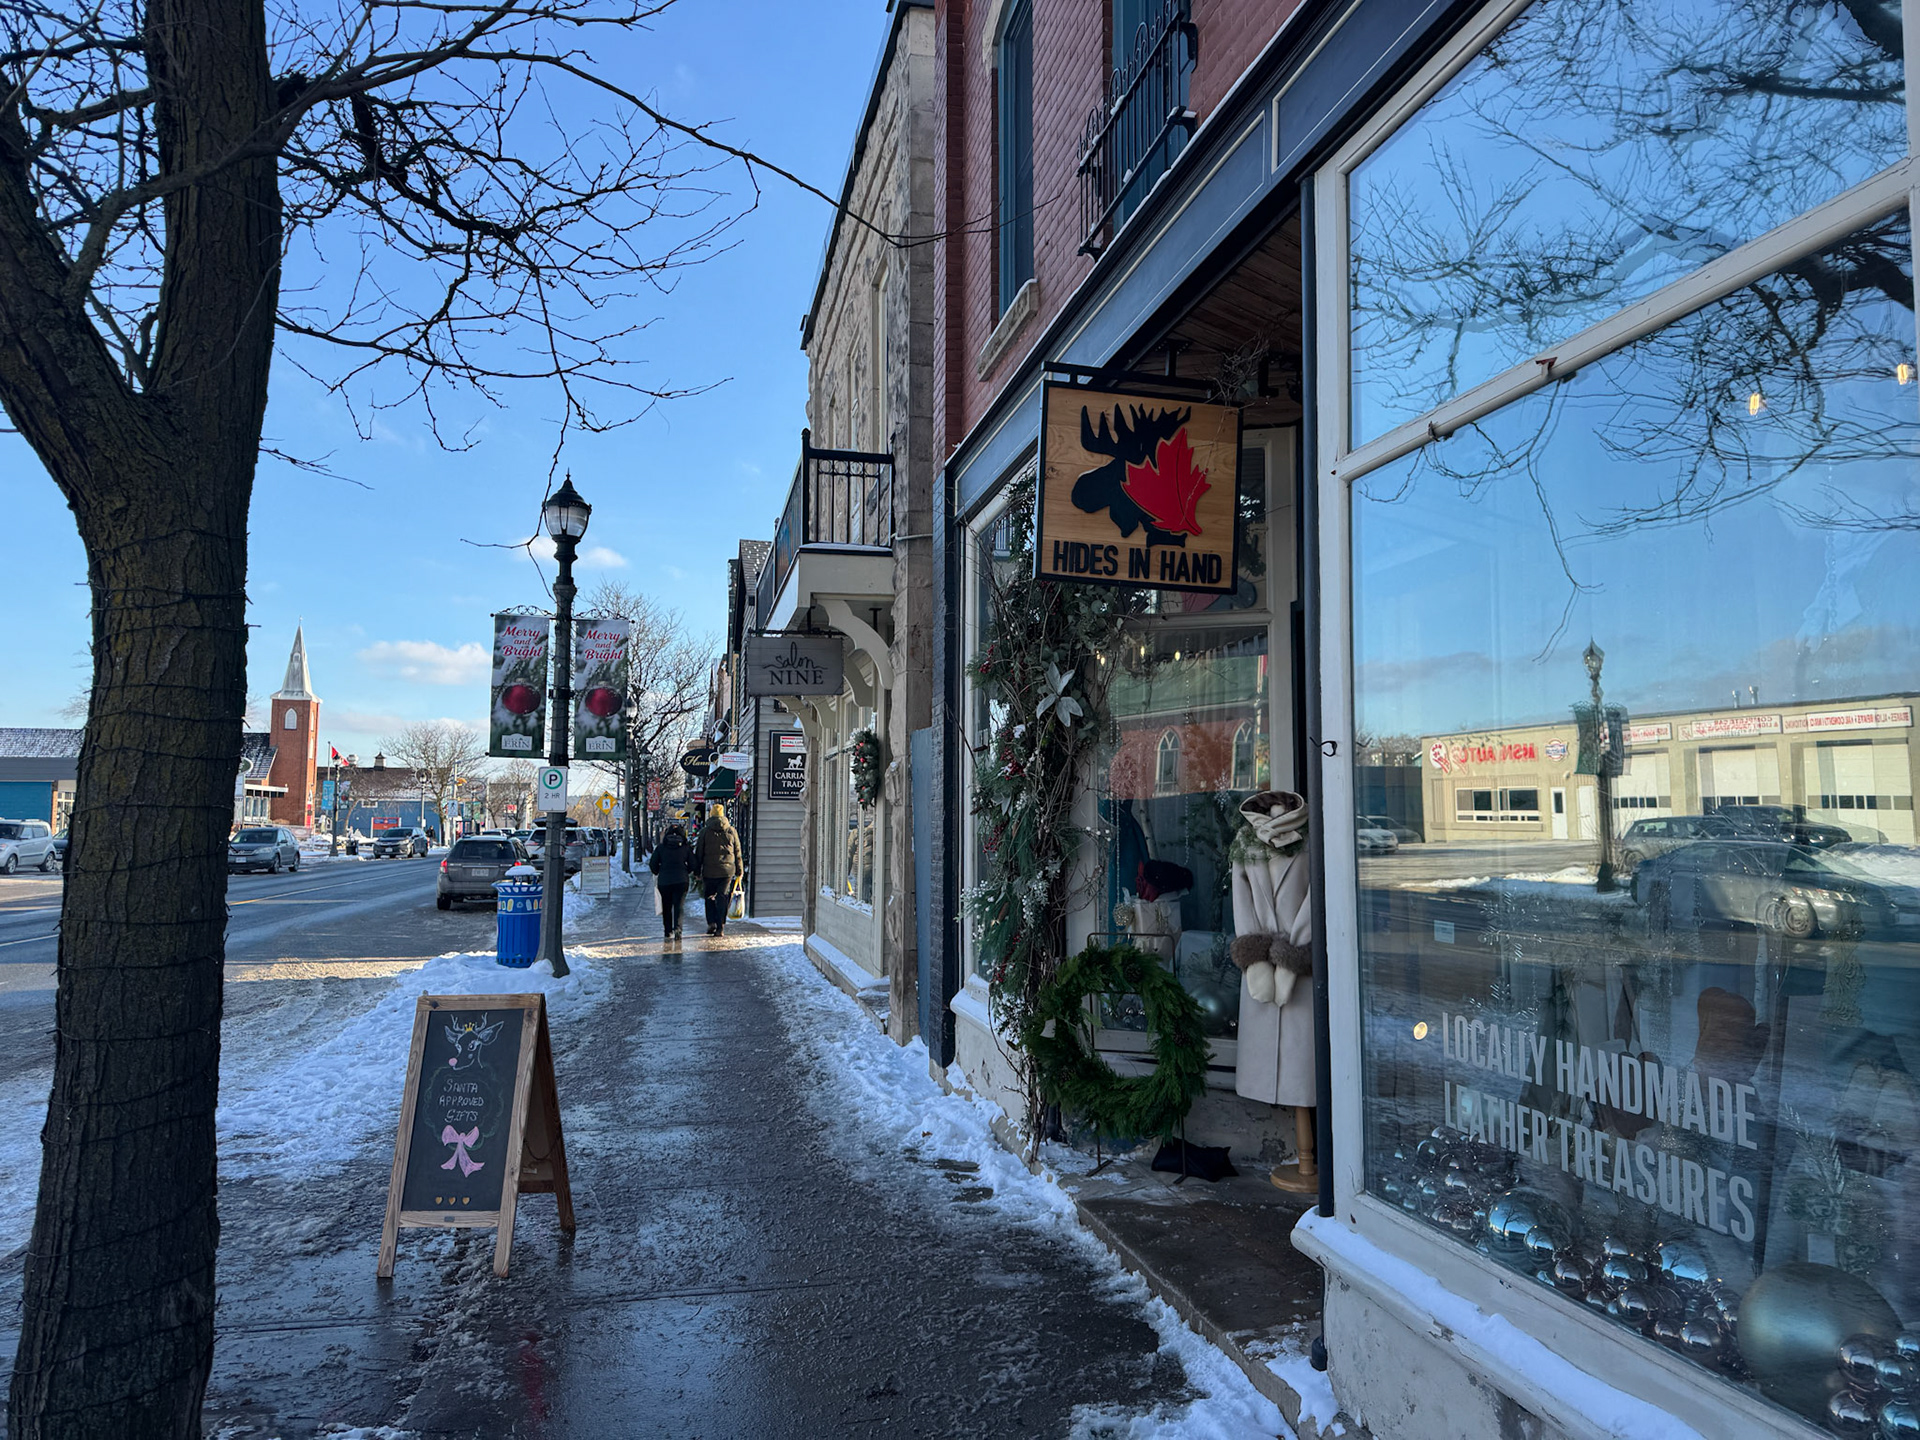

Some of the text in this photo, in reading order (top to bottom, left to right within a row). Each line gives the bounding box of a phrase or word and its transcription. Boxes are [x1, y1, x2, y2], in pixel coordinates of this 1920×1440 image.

[1053, 540, 1223, 584] HIDES IN HAND
[503, 626, 540, 639] Merry
[585, 630, 621, 643] Merry
[513, 638, 532, 646] and
[594, 641, 612, 649] and
[502, 645, 543, 659] Bright
[584, 648, 624, 663] Bright
[769, 669, 824, 685] NINE
[504, 740, 531, 748] ERIN
[588, 742, 614, 750] ERIN
[774, 771, 805, 780] CARRIA
[443, 1079, 478, 1093] SANTA
[1442, 1011, 1758, 1150] LOCALLY HANDMADE
[439, 1096, 484, 1106] APPROVED
[444, 1109, 479, 1123] GIFTS
[1444, 1080, 1756, 1243] LEATHER TREASURES
